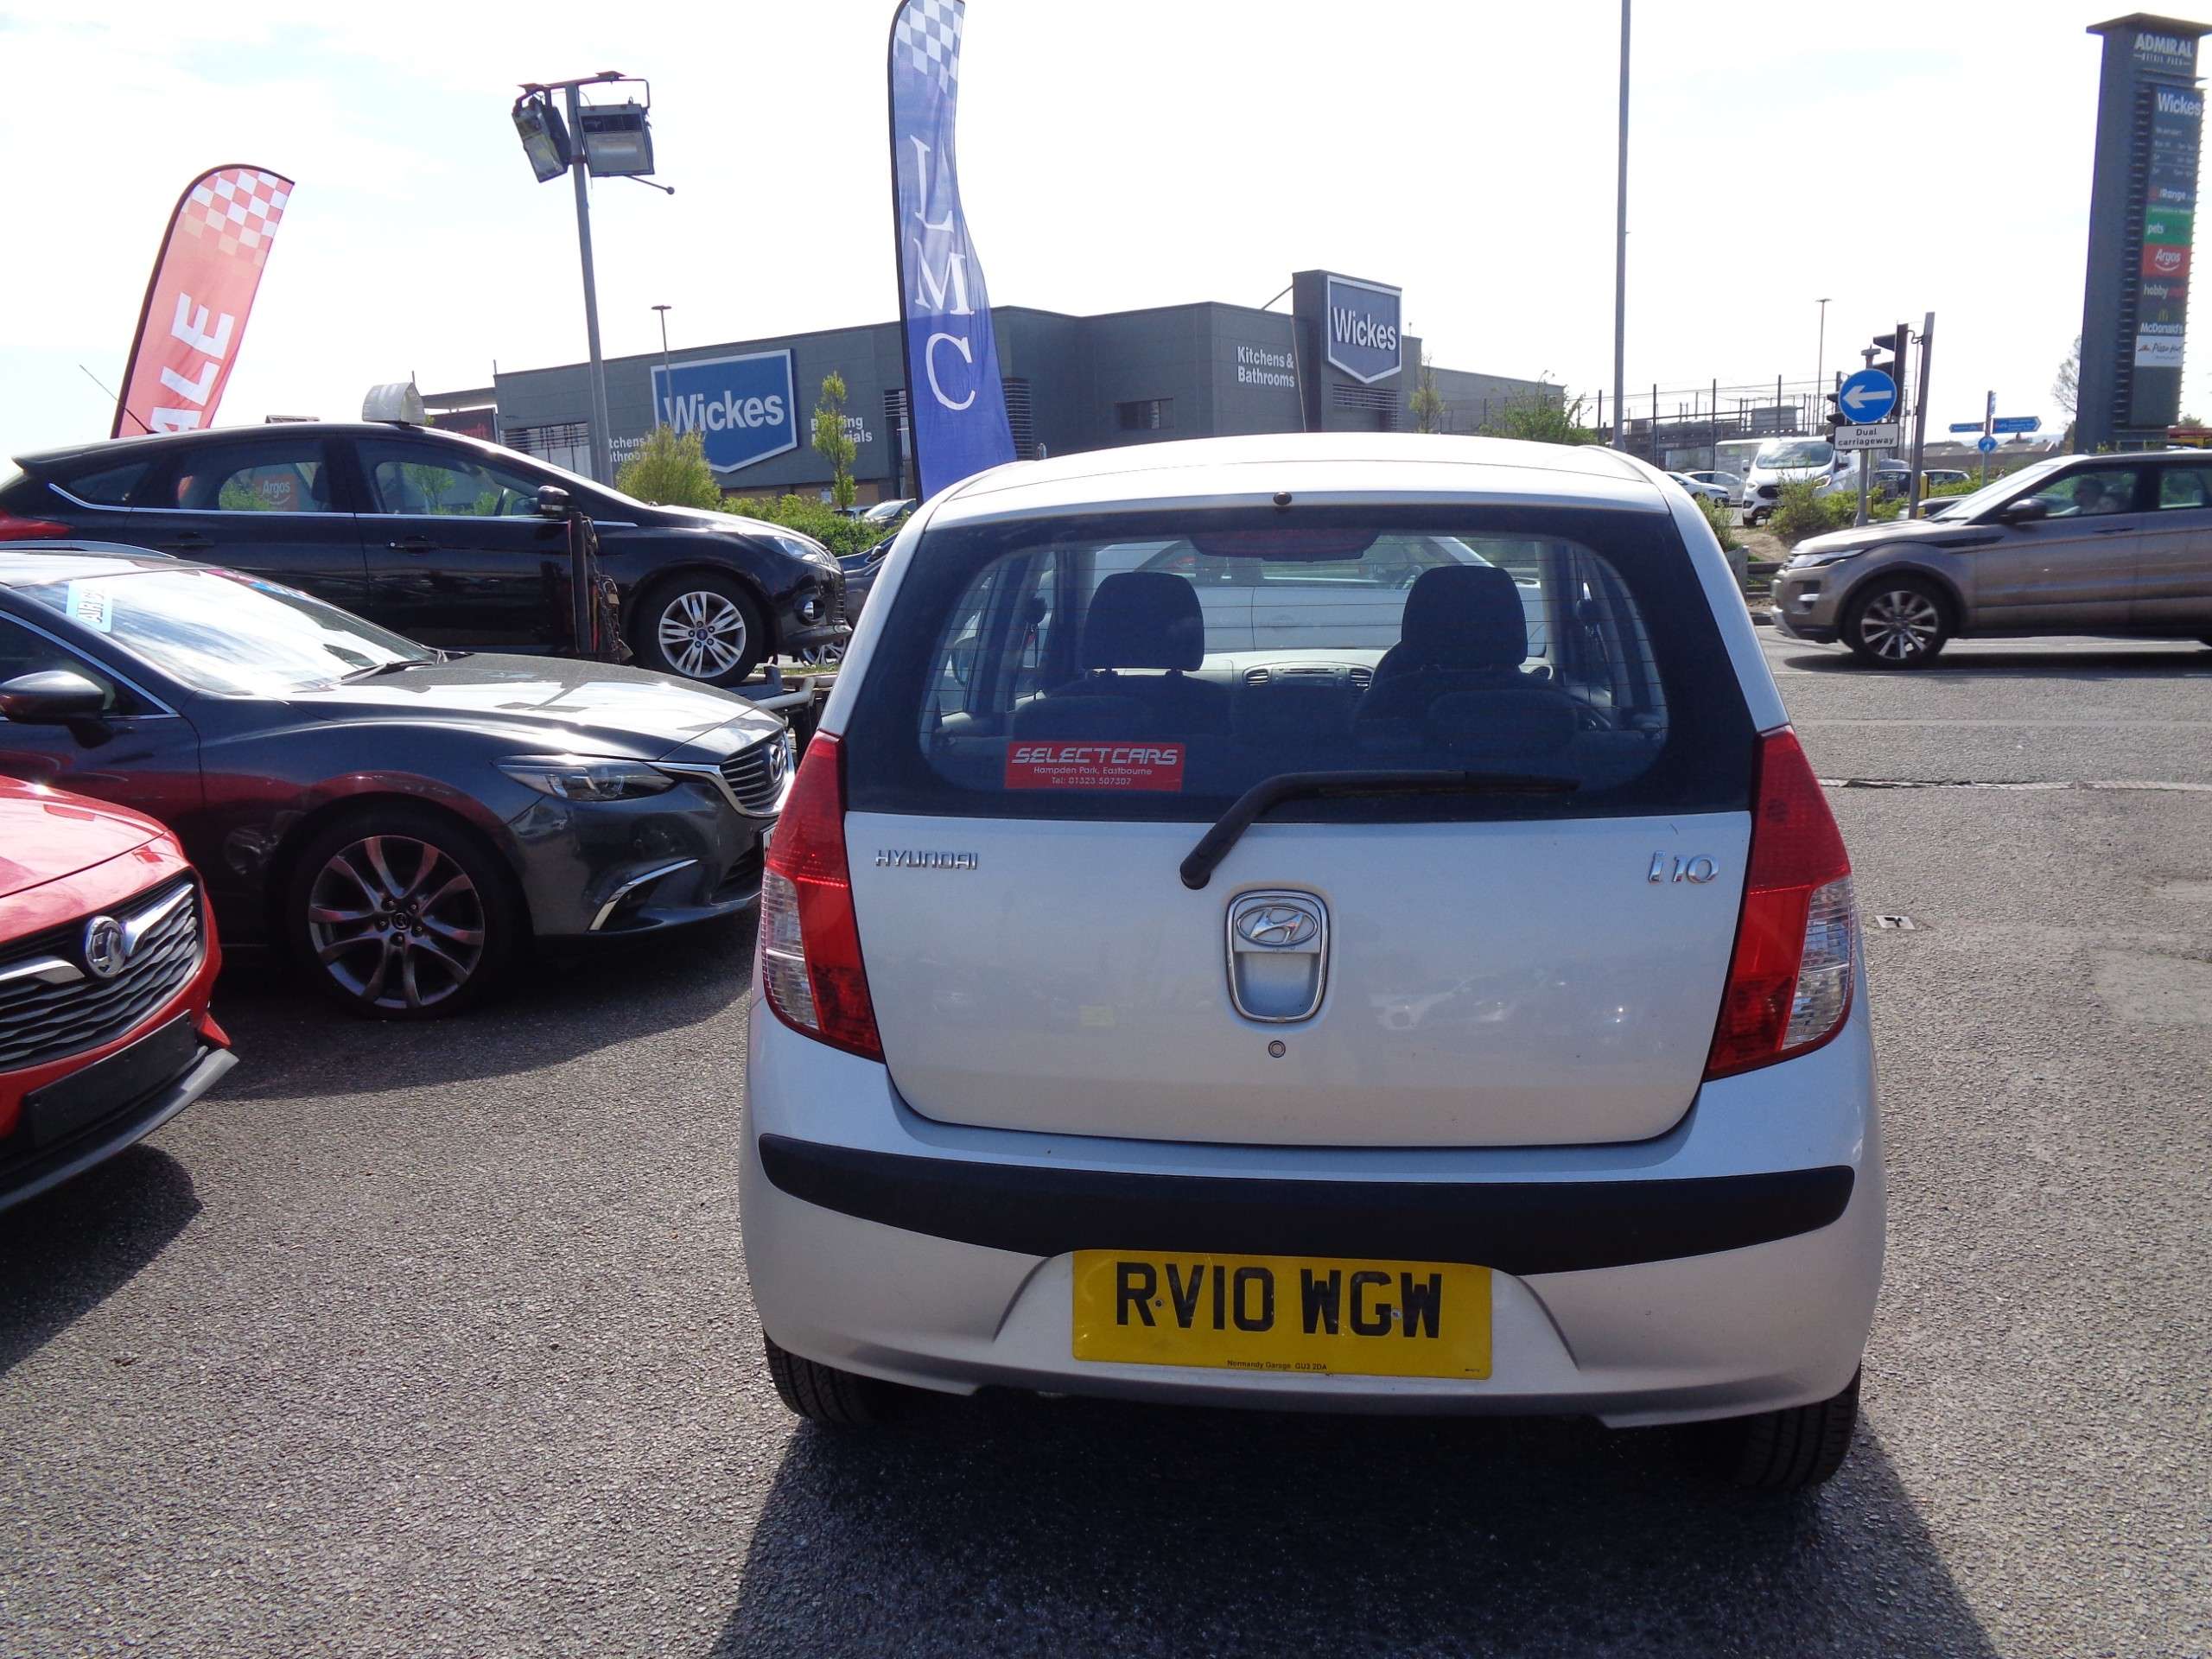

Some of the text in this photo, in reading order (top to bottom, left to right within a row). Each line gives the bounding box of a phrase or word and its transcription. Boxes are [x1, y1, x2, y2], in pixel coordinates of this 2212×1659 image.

[2133, 32, 2193, 57] ADMIRAL
[2158, 92, 2202, 116] Wickes
[2154, 248, 2181, 264] Argos
[1333, 306, 1396, 351] Wickes
[150, 292, 235, 433] ALE
[1237, 346, 1294, 369] Kitchens &
[1238, 366, 1294, 387] Bathrooms
[664, 391, 785, 434] Wickes
[608, 435, 645, 449] tchens
[1838, 436, 1894, 448] carriageway
[1856, 428, 1877, 437] Dual
[263, 480, 291, 499] Argos
[875, 849, 978, 870] HYUNDAI
[1116, 1262, 1442, 1338] RV10 WGW
[1227, 1360, 1263, 1370] Normandy
